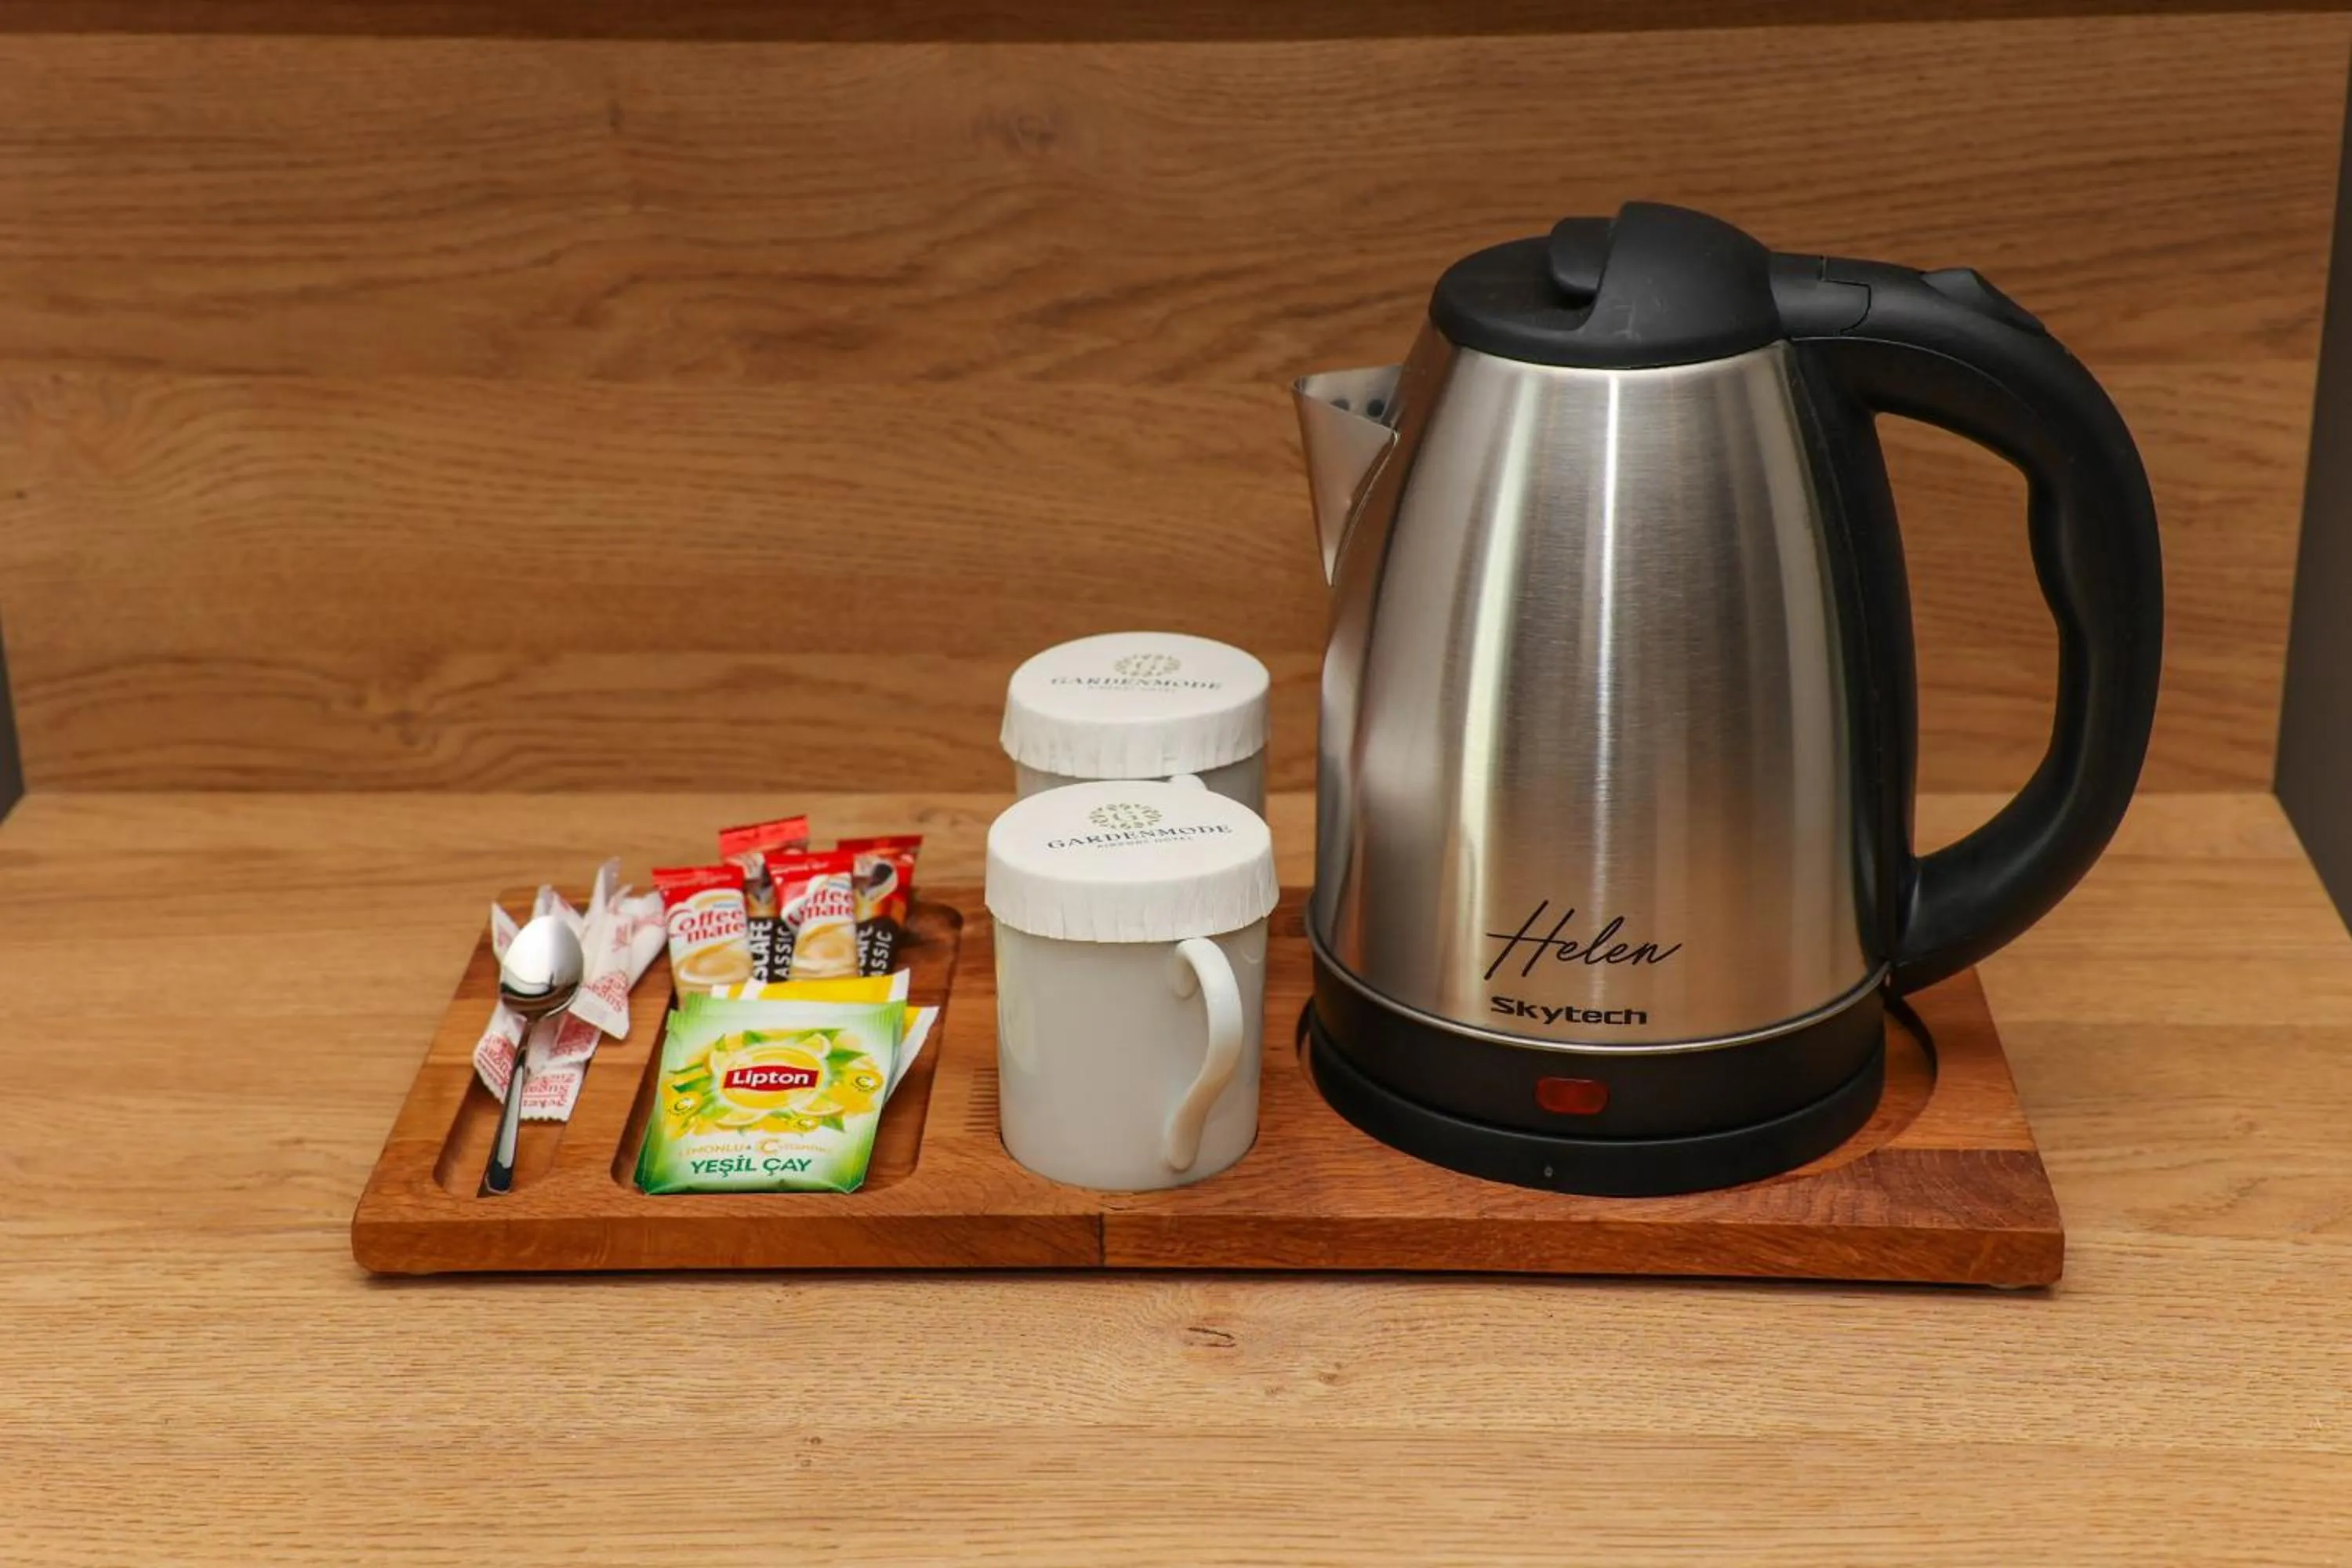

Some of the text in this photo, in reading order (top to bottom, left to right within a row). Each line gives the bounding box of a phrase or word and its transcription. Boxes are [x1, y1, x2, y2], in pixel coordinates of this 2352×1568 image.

[1051, 677, 1222, 691] GARDENMODE
[1047, 824, 1233, 850] GARDENMODE
[666, 909, 743, 937] Coffee
[687, 922, 747, 944] mate
[750, 919, 773, 982] SCAFE
[774, 925, 793, 981] ASSIC
[1484, 899, 1682, 980] Helen
[1490, 996, 1647, 1025] Skytech
[731, 1071, 809, 1087] Lipton
[691, 1155, 812, 1178] YEŞİL ÇAY
